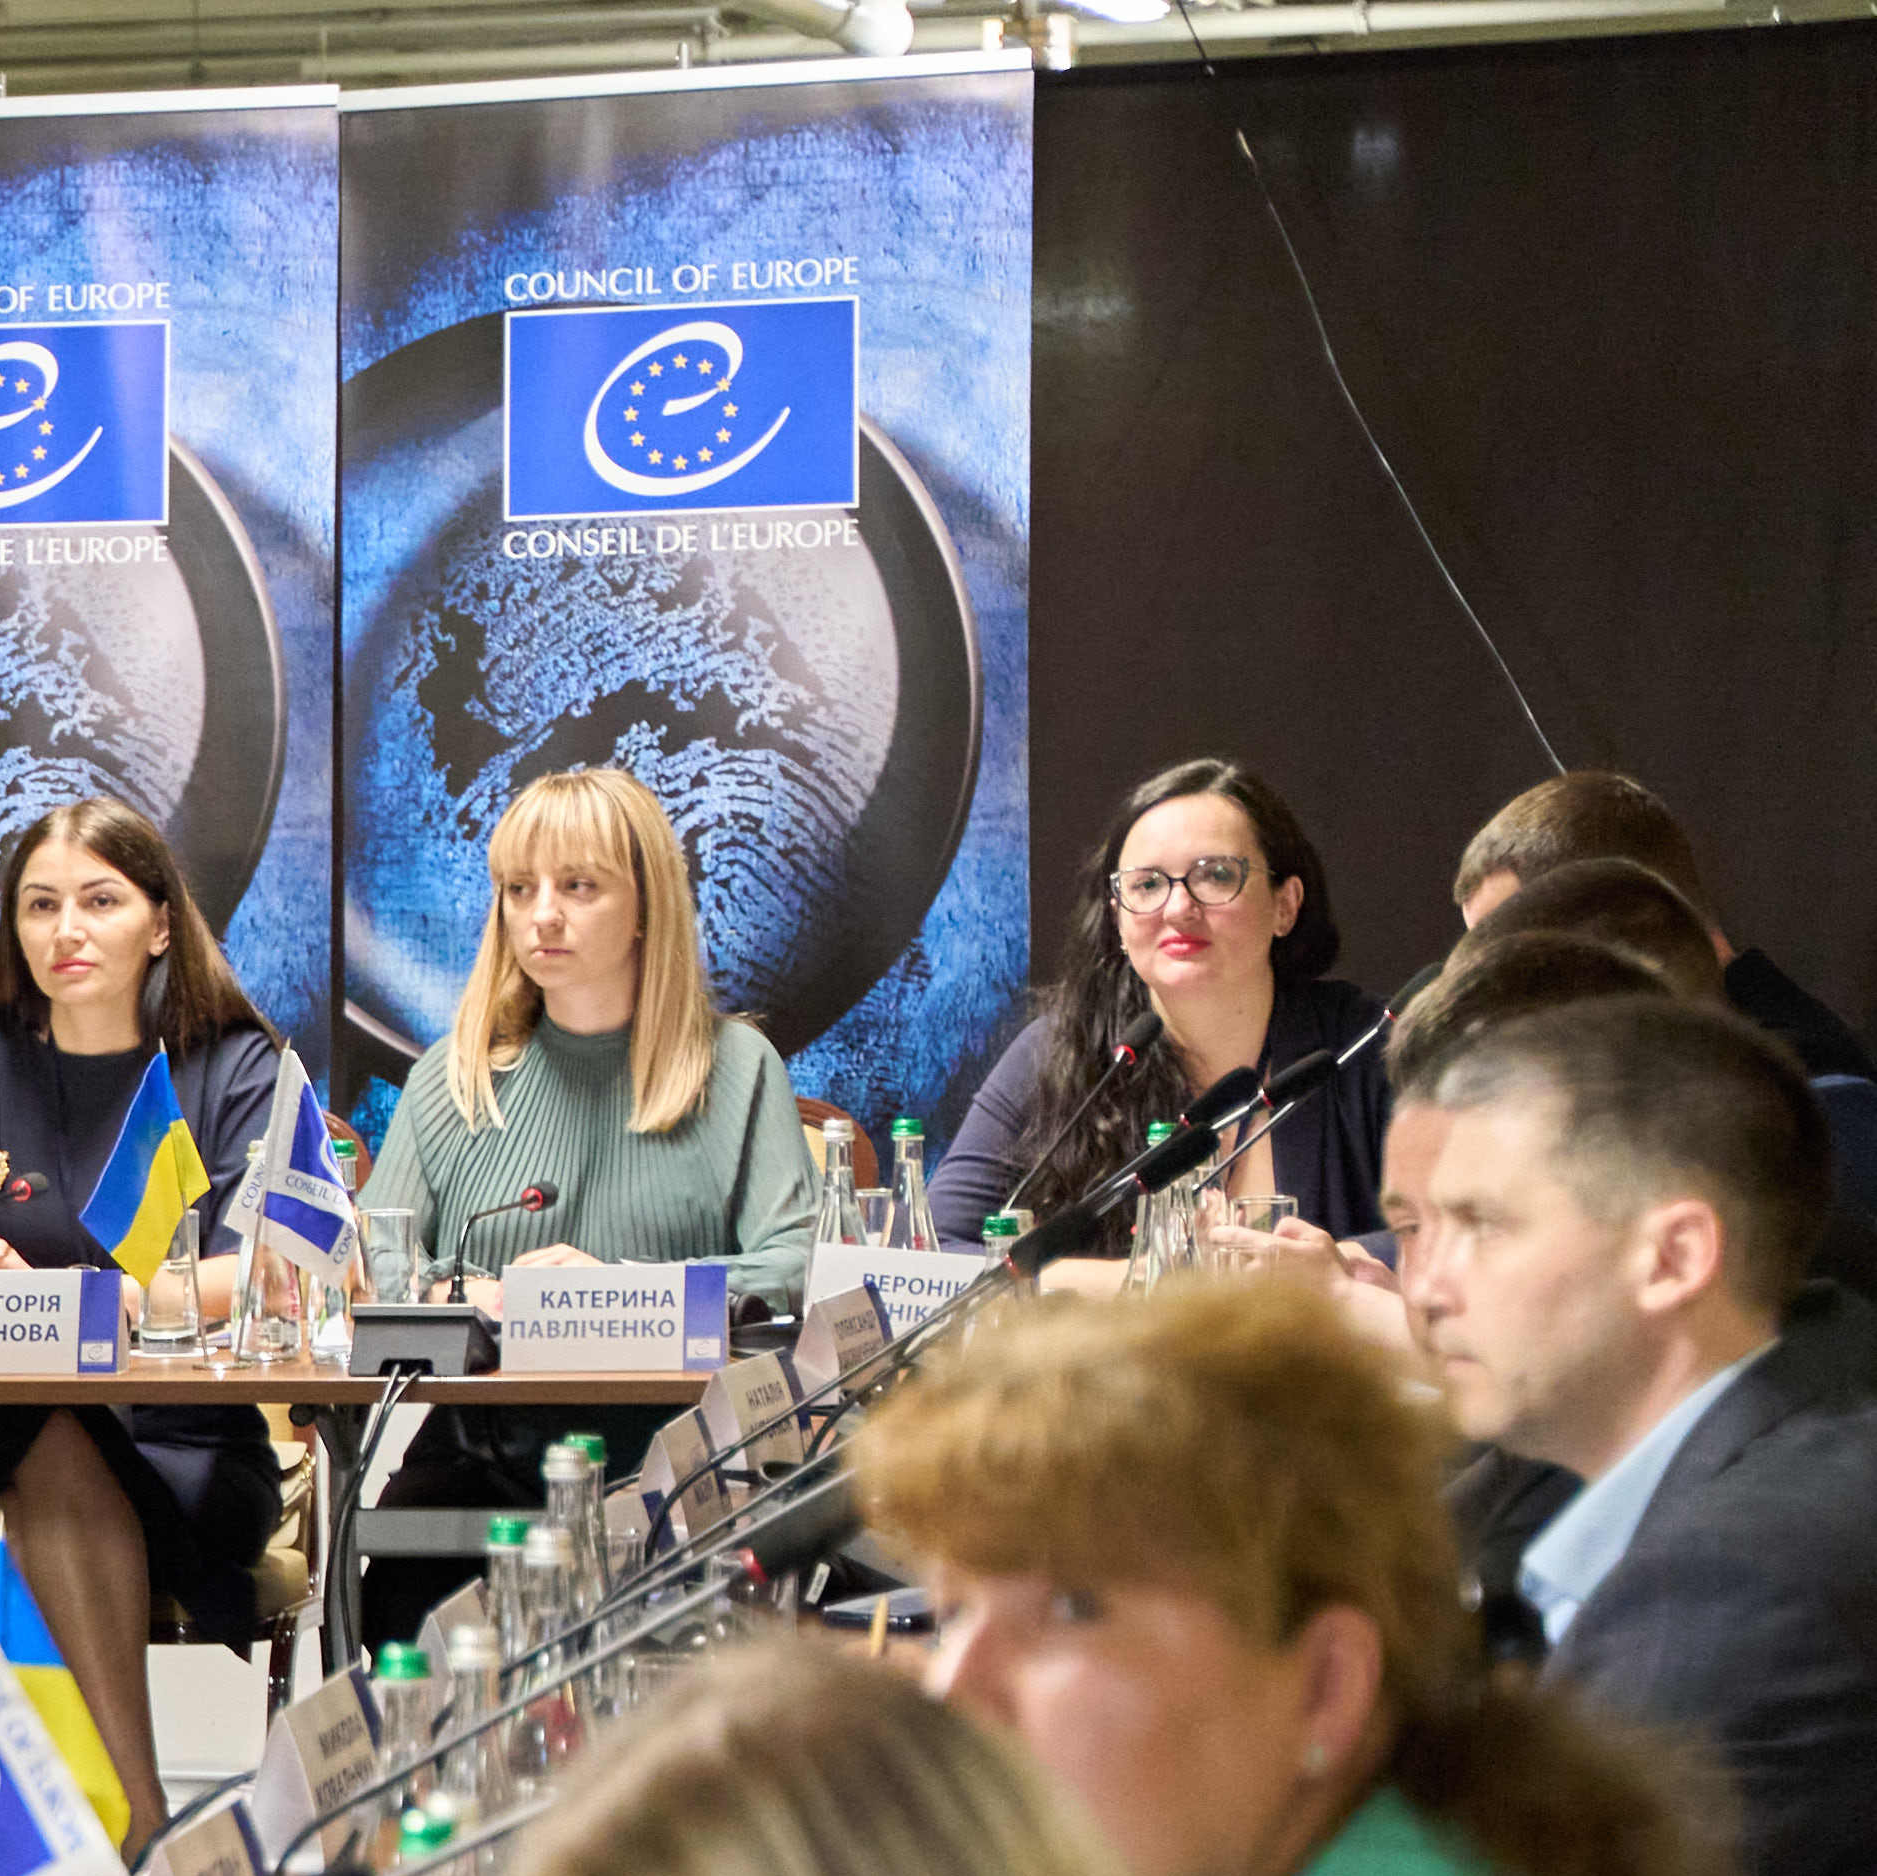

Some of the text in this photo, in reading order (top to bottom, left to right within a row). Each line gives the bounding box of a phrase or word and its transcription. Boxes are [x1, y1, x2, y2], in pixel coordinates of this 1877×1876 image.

[504, 256, 860, 301] COUNCIL OF EUROPE
[49, 281, 171, 312] EUROPE
[26, 535, 169, 565] L'EUROPE
[503, 518, 860, 559] CONSEIL DE L'EUROPE
[540, 1289, 677, 1309] КАТЕРИНА
[862, 1272, 969, 1298] ВЕРОНІК
[509, 1318, 677, 1339] ПАВЛІЧЕНКО
